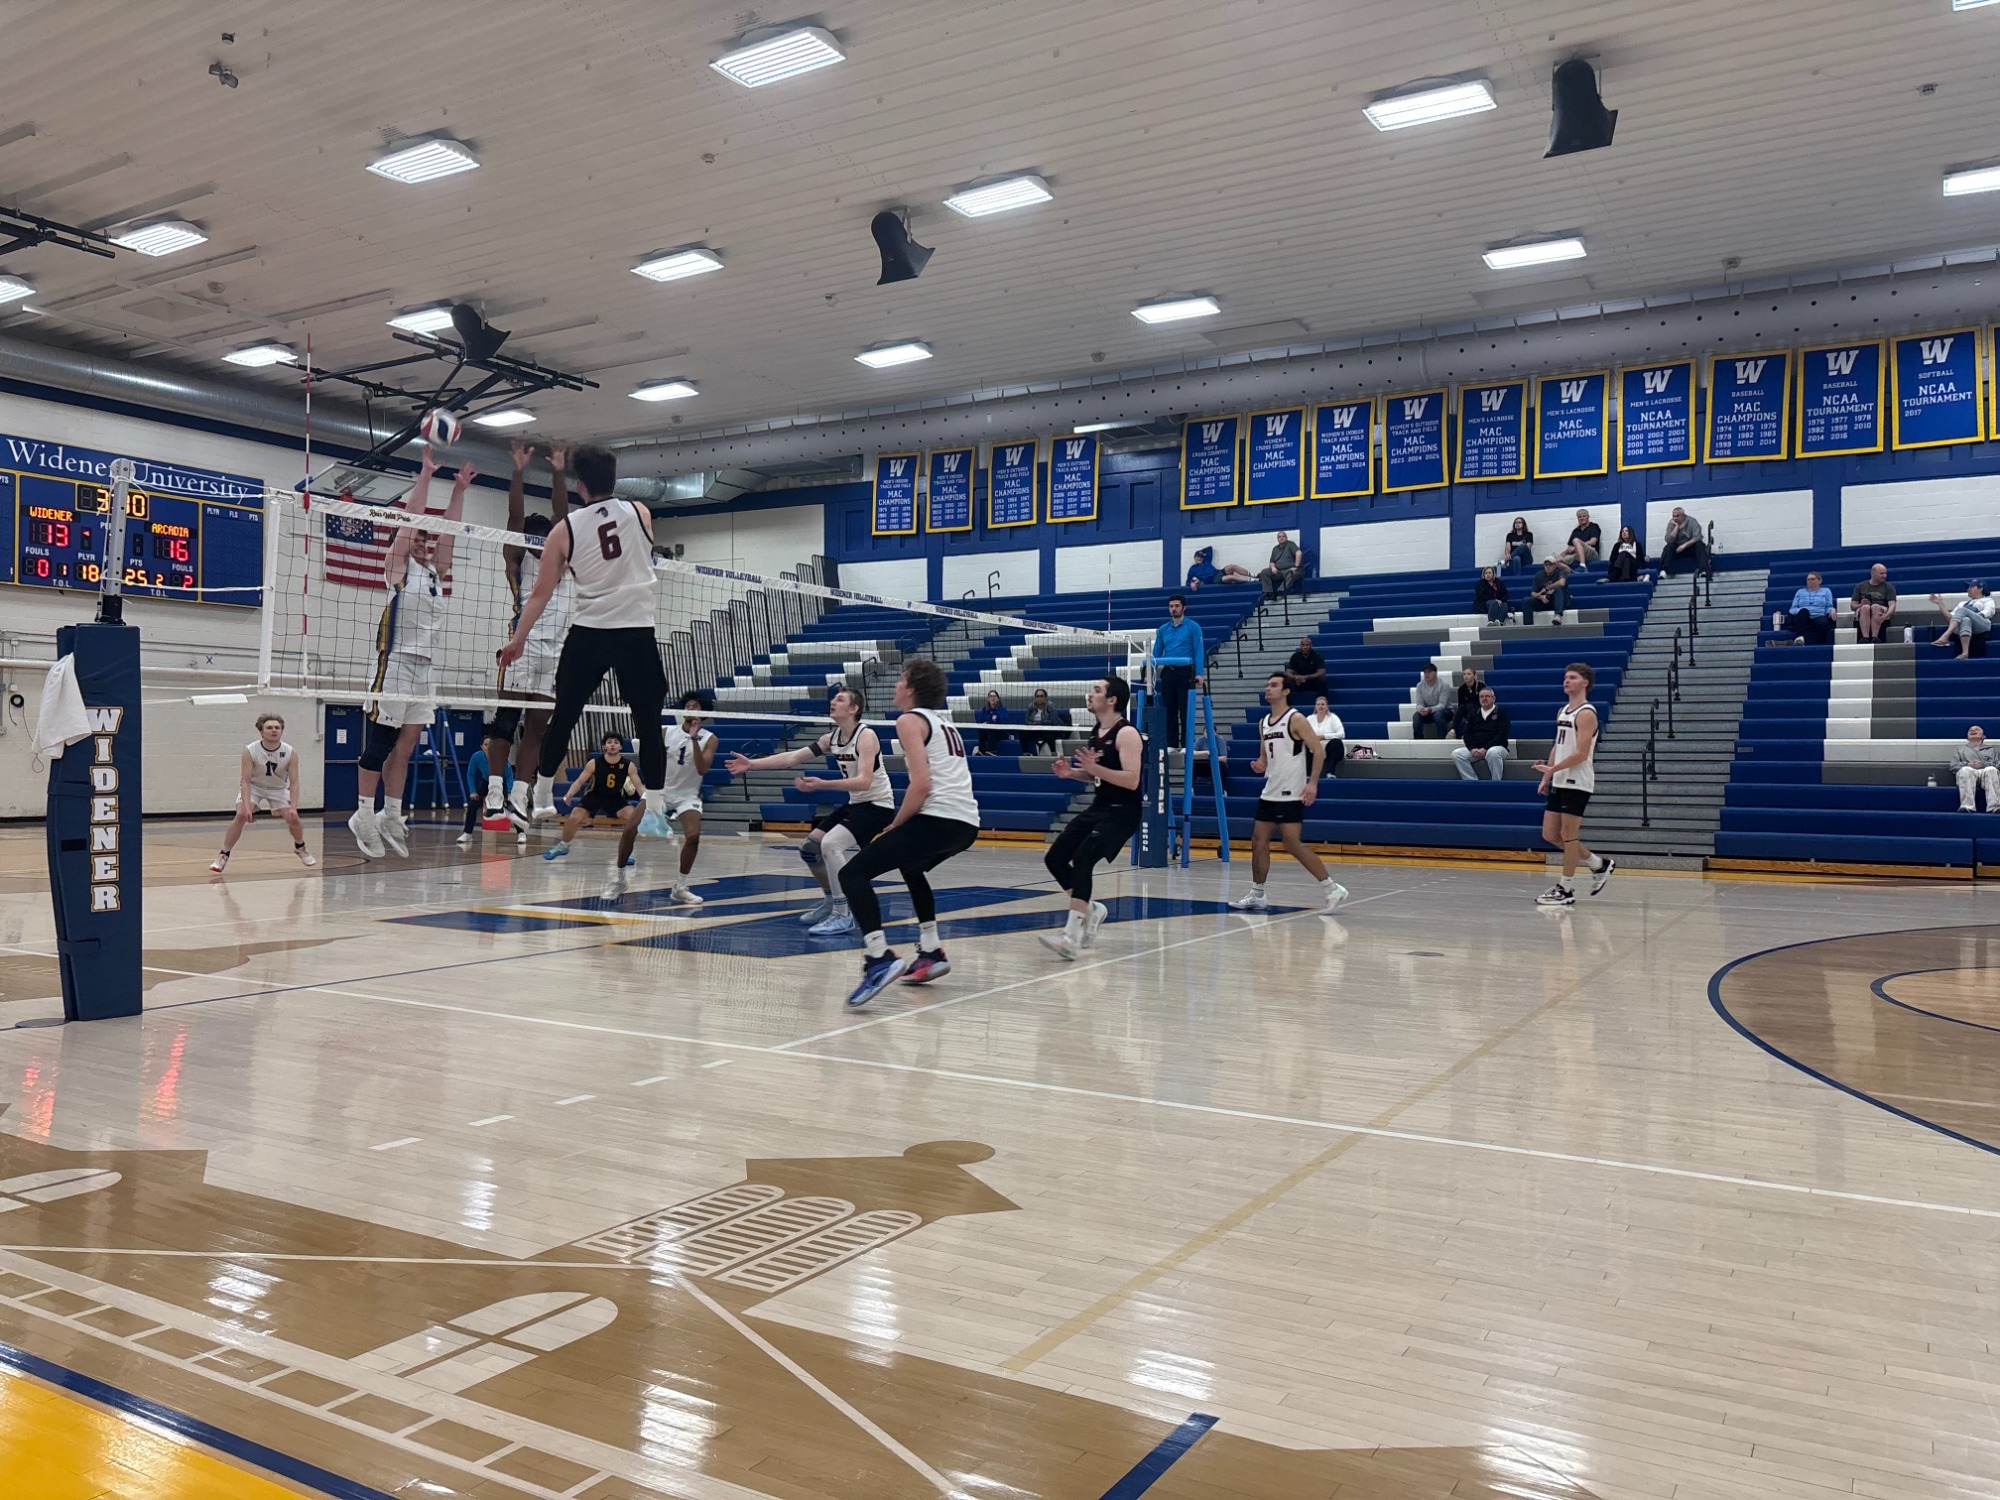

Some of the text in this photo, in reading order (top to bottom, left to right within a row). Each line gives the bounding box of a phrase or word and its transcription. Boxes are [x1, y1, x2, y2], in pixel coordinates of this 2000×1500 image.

[1920, 338, 1954, 365] W
[1826, 350, 1859, 376] W
[1735, 360, 1767, 384] W
[1918, 370, 1954, 379] SOFTBALL
[1643, 369, 1672, 394] W
[1823, 381, 1858, 389] BASEBALL
[1560, 380, 1588, 404] W
[1731, 390, 1765, 398] BASEBALL
[1919, 382, 1956, 396] NCAA
[1481, 389, 1507, 412] W
[1630, 397, 1682, 408] MEN'S LACROSSE
[1822, 393, 1858, 406] NCAA
[1903, 392, 1973, 407] TOURNAMENT
[1404, 398, 1428, 420] W
[1566, 406, 1595, 414] LACROSSE
[1734, 402, 1761, 413] MAC
[1807, 403, 1874, 417] TOURNAMENT
[1904, 409, 1922, 417] 2017
[1333, 407, 1357, 429] W
[1640, 410, 1672, 422] NCAA
[1717, 412, 1777, 424] CHAMPIONS
[1808, 414, 1871, 426] 1976 1977 1978
[1266, 415, 1289, 436] W
[1559, 420, 1582, 430] MAC
[1626, 419, 1686, 432] TOURNAMENT
[1808, 422, 1872, 434] 1982 1999 2010
[1202, 422, 1224, 443] W
[1480, 427, 1502, 436] MAC
[1545, 428, 1597, 441] CHAMPIONS
[1668, 429, 1684, 437] 2003
[1404, 435, 1425, 446] MAC
[1466, 436, 1515, 447] CHAMPIONS
[1808, 434, 1825, 442] 2014
[1066, 440, 1085, 459] W
[1332, 444, 1352, 454] MAC
[1391, 444, 1438, 456] CHAMPIONS
[1627, 441, 1643, 449] 2005
[1006, 447, 1024, 466] W
[1265, 451, 1284, 460] MAC
[1320, 453, 1364, 463] CHAMPIONS
[890, 459, 907, 477] W
[944, 454, 961, 472] W
[1201, 458, 1219, 467] MAC
[1253, 459, 1296, 470] CHAMPIONS
[1189, 466, 1230, 476] CHAMPIONS
[1064, 473, 1081, 482] MAC
[132, 463, 248, 505] University
[942, 486, 957, 494] MAC
[1004, 480, 1020, 488] MAC
[1054, 481, 1090, 490] CHAMPIONS
[888, 490, 902, 498] MAC
[932, 494, 966, 502] CHAMPIONS
[995, 487, 1030, 497] CHAMPIONS
[30, 506, 73, 522] WIDENER
[48, 524, 68, 546] 13
[152, 524, 189, 538] ARCADIA
[598, 520, 622, 561] 6
[26, 547, 49, 556] FOULS
[170, 540, 188, 561] 16
[78, 553, 95, 561] PLYR
[38, 559, 48, 577] 0
[83, 564, 99, 582] 18
[172, 564, 193, 572] FOULS
[125, 569, 148, 586] 25
[156, 574, 163, 586] 2
[696, 565, 762, 584] WIDENER VOLLEYBALL
[182, 575, 193, 589] 2
[941, 724, 965, 758] 10
[677, 746, 687, 765] 1
[607, 774, 616, 788] 6
[86, 706, 124, 912] WIDENER
